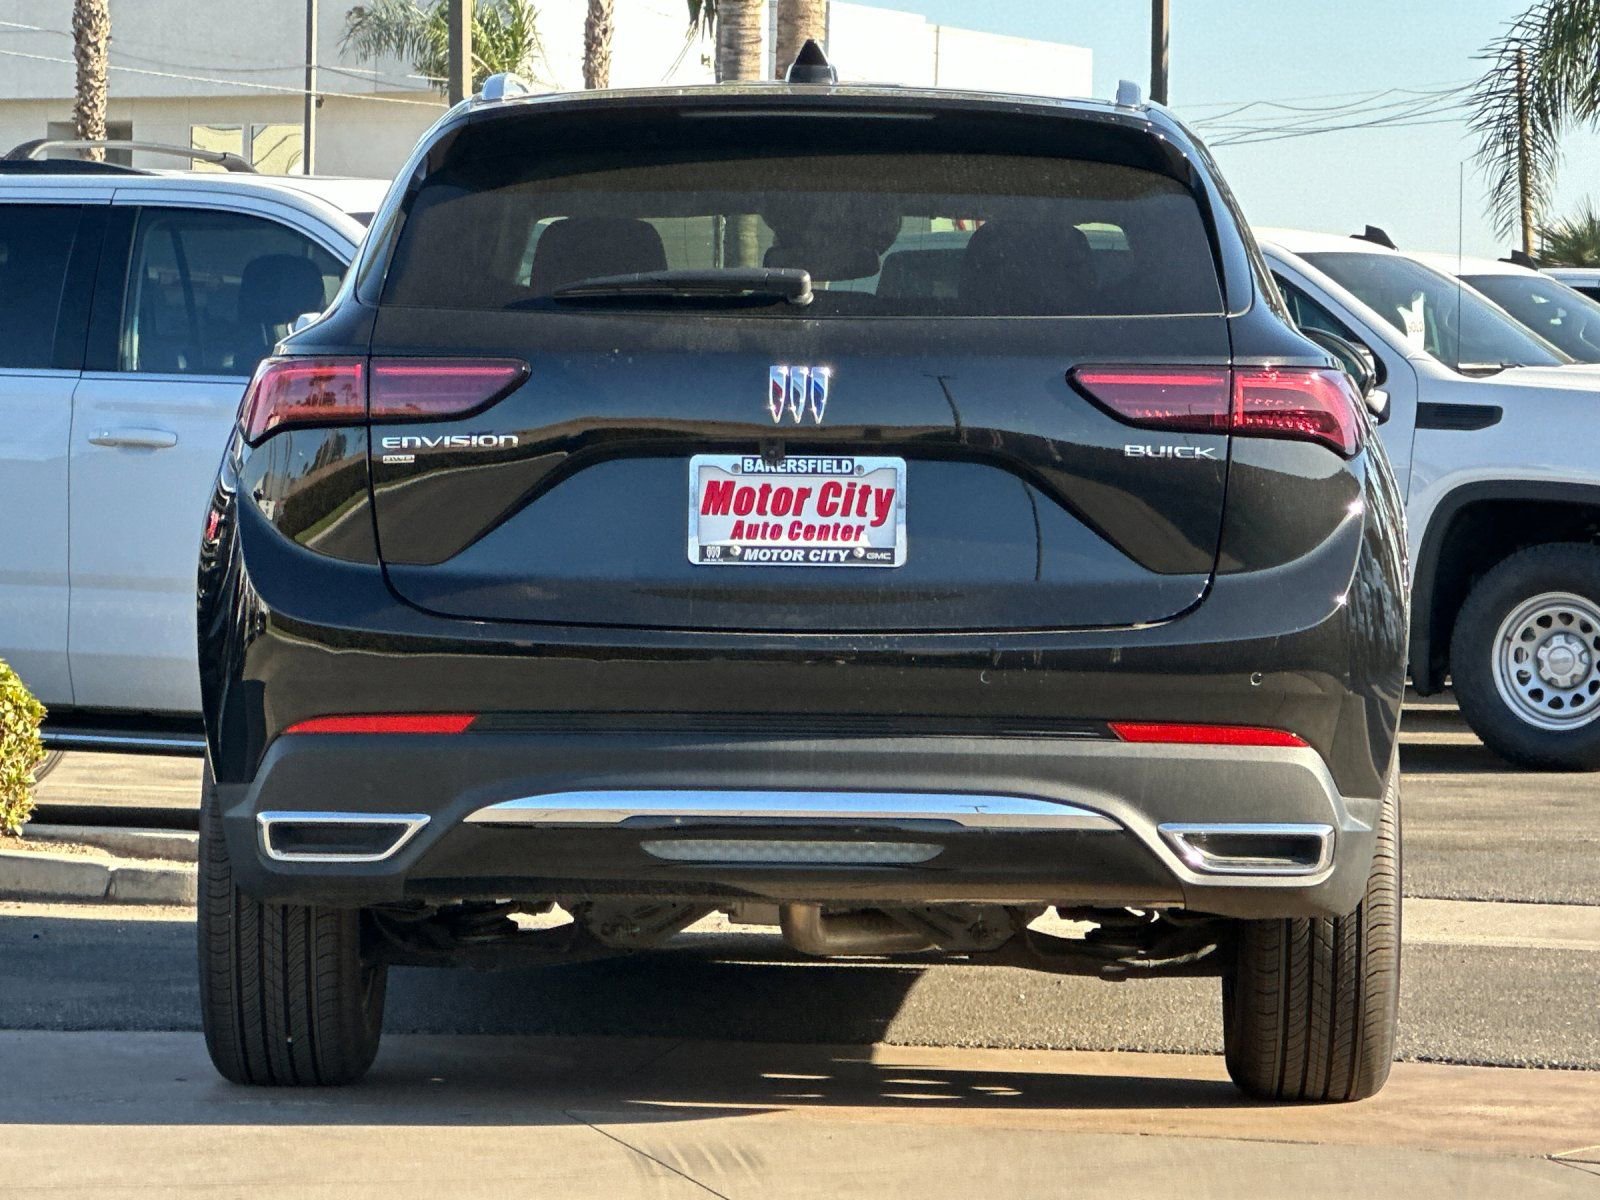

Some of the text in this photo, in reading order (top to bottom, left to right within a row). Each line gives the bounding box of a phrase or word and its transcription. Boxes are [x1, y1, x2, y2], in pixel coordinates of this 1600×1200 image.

[382, 435, 519, 448] ENVISION
[1125, 445, 1218, 459] BUICK
[701, 480, 896, 527] Motor City
[730, 520, 865, 542] Auto Center
[743, 548, 850, 562] MOTOR CITY
[866, 552, 891, 560] GMC
